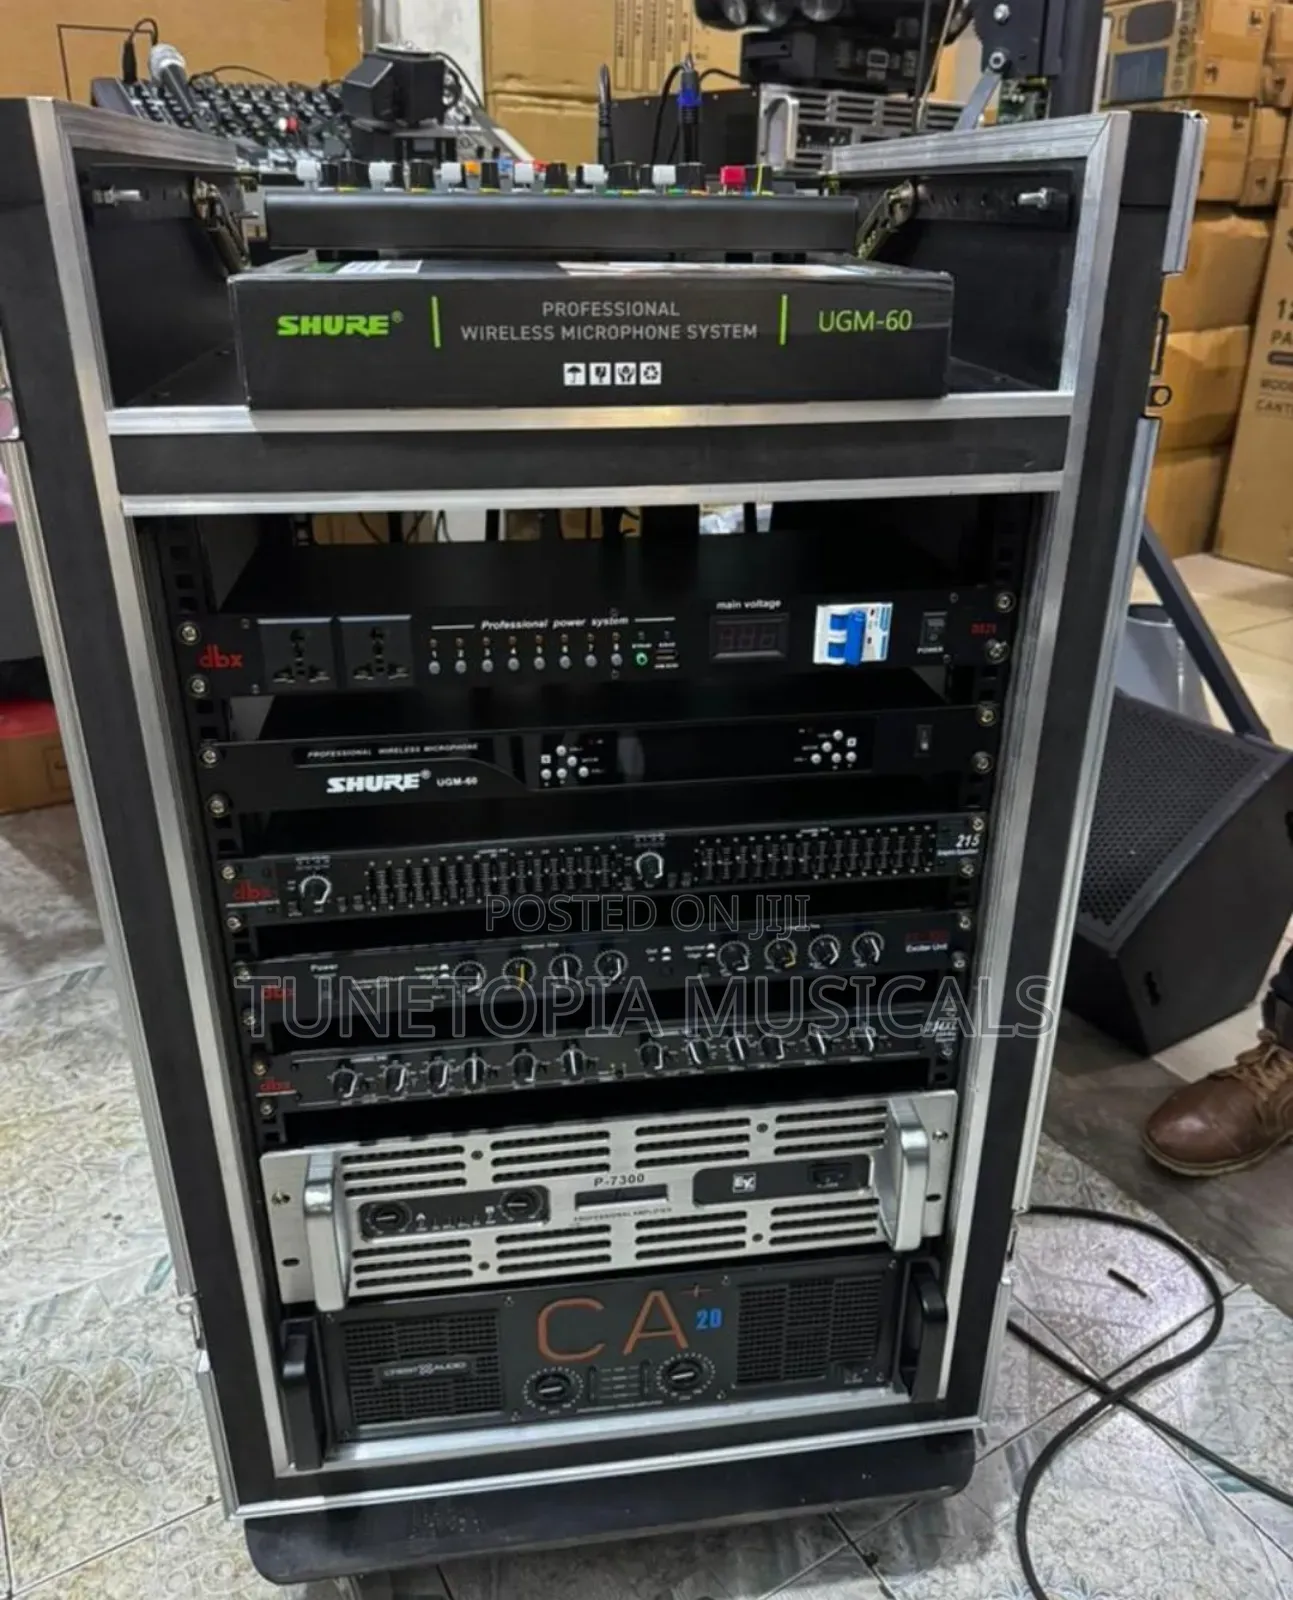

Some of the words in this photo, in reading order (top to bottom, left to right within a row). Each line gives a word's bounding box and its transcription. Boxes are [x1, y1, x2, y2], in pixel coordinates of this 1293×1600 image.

[542, 301, 680, 318] PROFESSIONAL
[818, 309, 914, 333] UGM-60
[460, 324, 554, 341] WIRELESS
[561, 324, 681, 340] MICROPHONE
[686, 323, 758, 340] SYSTEM
[716, 600, 742, 610] main
[744, 598, 782, 610] voltage
[481, 619, 548, 631] Professional
[552, 619, 586, 630] power
[591, 617, 629, 627] system
[199, 643, 243, 668] dbx
[307, 749, 372, 759] PROFESSIONAL
[378, 746, 420, 756] WIRELESS
[424, 743, 478, 754] MICROPHONE
[955, 834, 980, 848] 215
[593, 1173, 645, 1188] P-7300
[696, 1307, 722, 1331] 20
